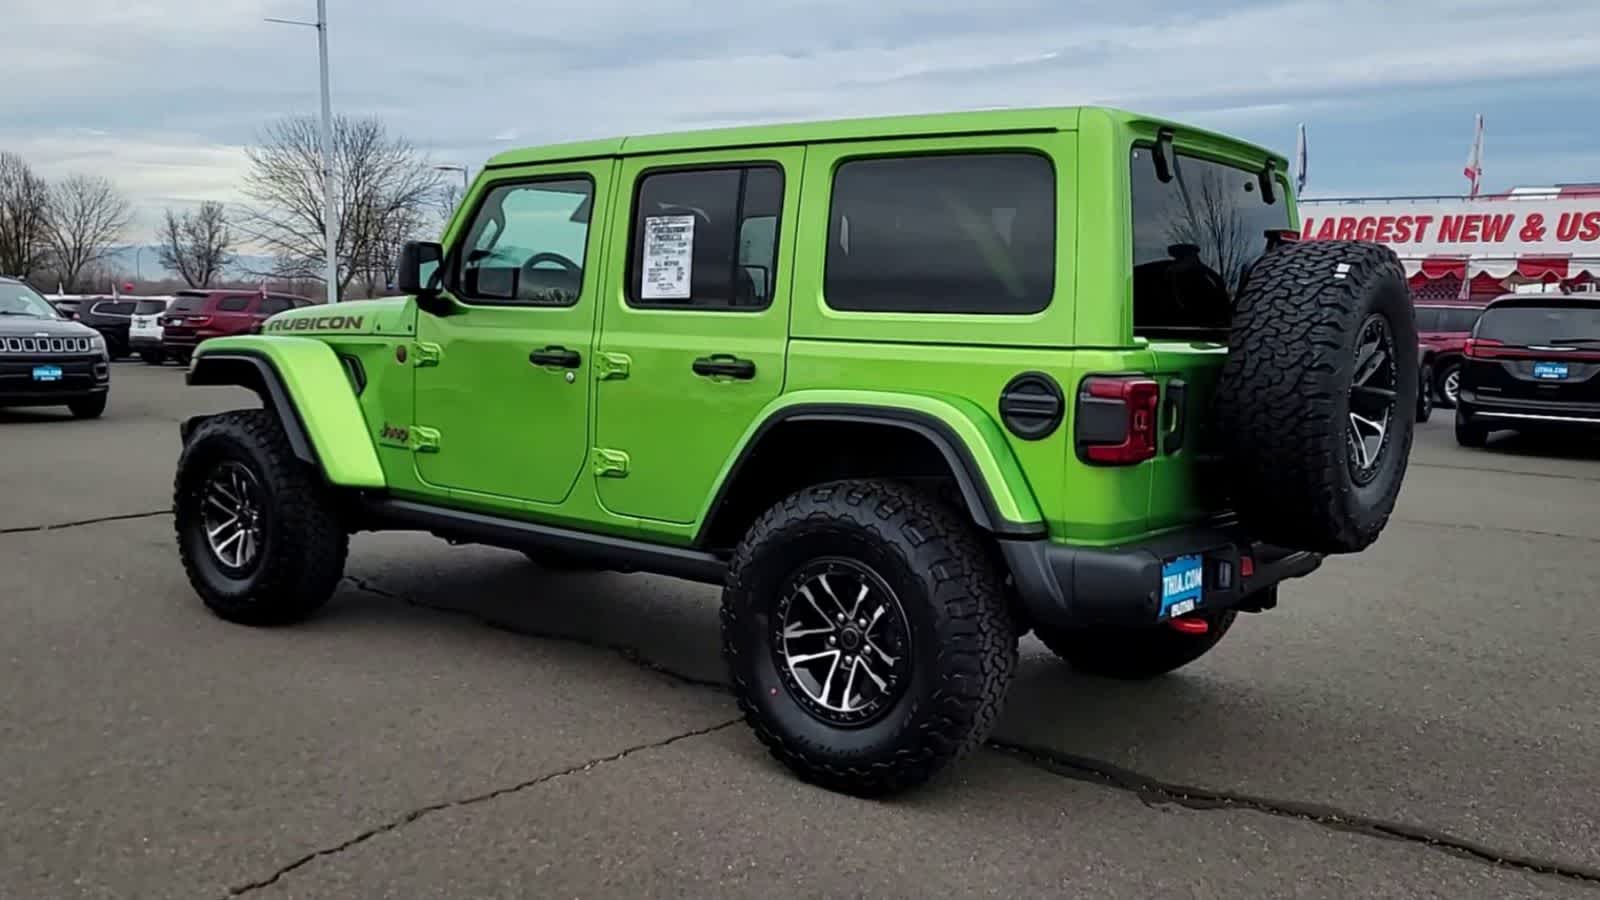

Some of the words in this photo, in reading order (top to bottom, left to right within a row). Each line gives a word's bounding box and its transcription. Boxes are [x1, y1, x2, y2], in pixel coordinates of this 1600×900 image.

[1302, 215, 1433, 243] LARGEST
[1438, 213, 1515, 243] NEW
[1519, 213, 1547, 242] &
[1556, 210, 1600, 242] US
[268, 315, 365, 331] RUBICON
